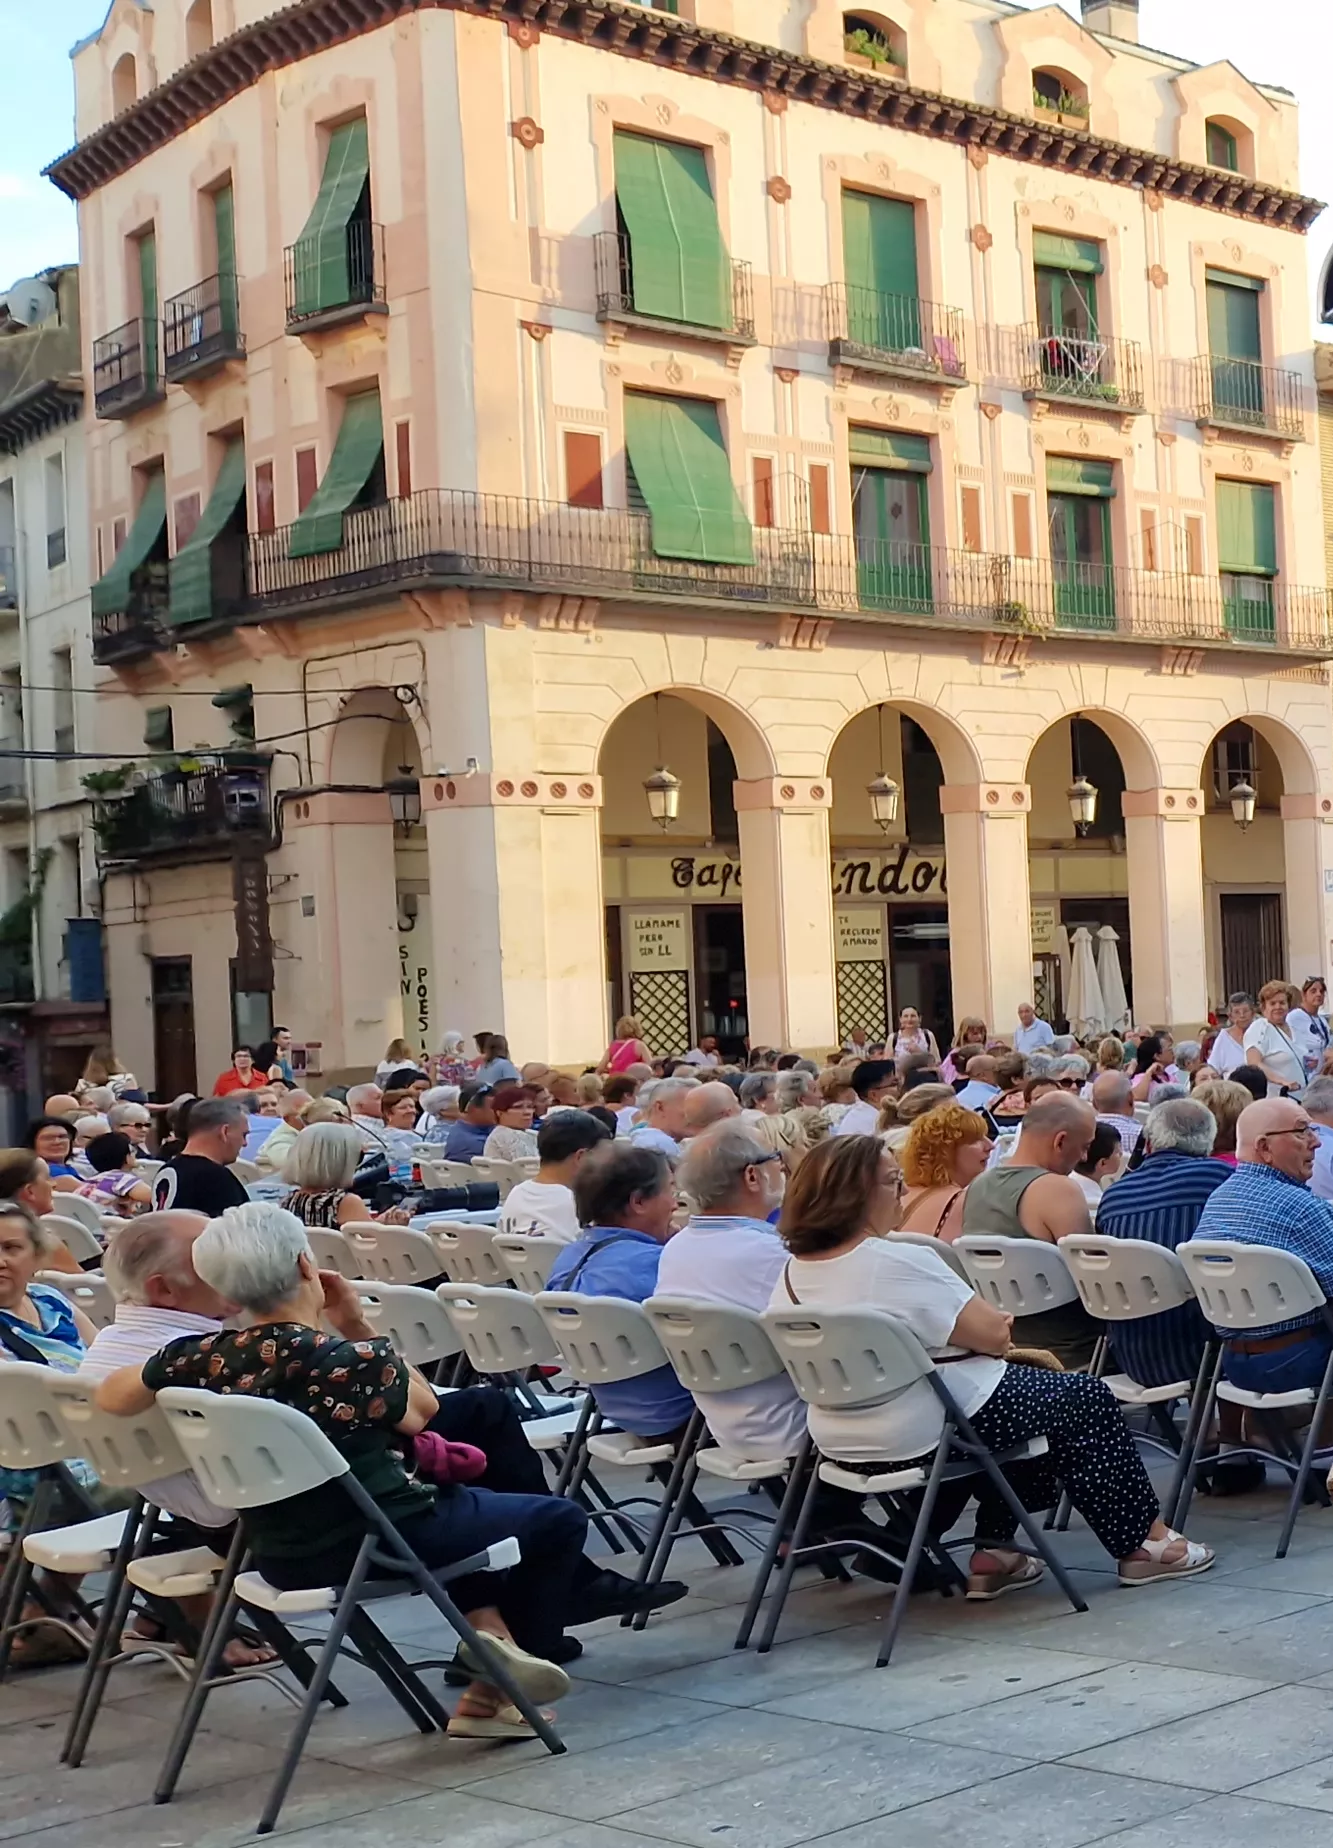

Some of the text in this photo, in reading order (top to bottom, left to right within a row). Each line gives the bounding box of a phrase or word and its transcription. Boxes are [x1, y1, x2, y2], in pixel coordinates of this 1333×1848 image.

[639, 933, 663, 942] PERO
[658, 944, 673, 956] LL
[398, 945, 412, 995] SIN
